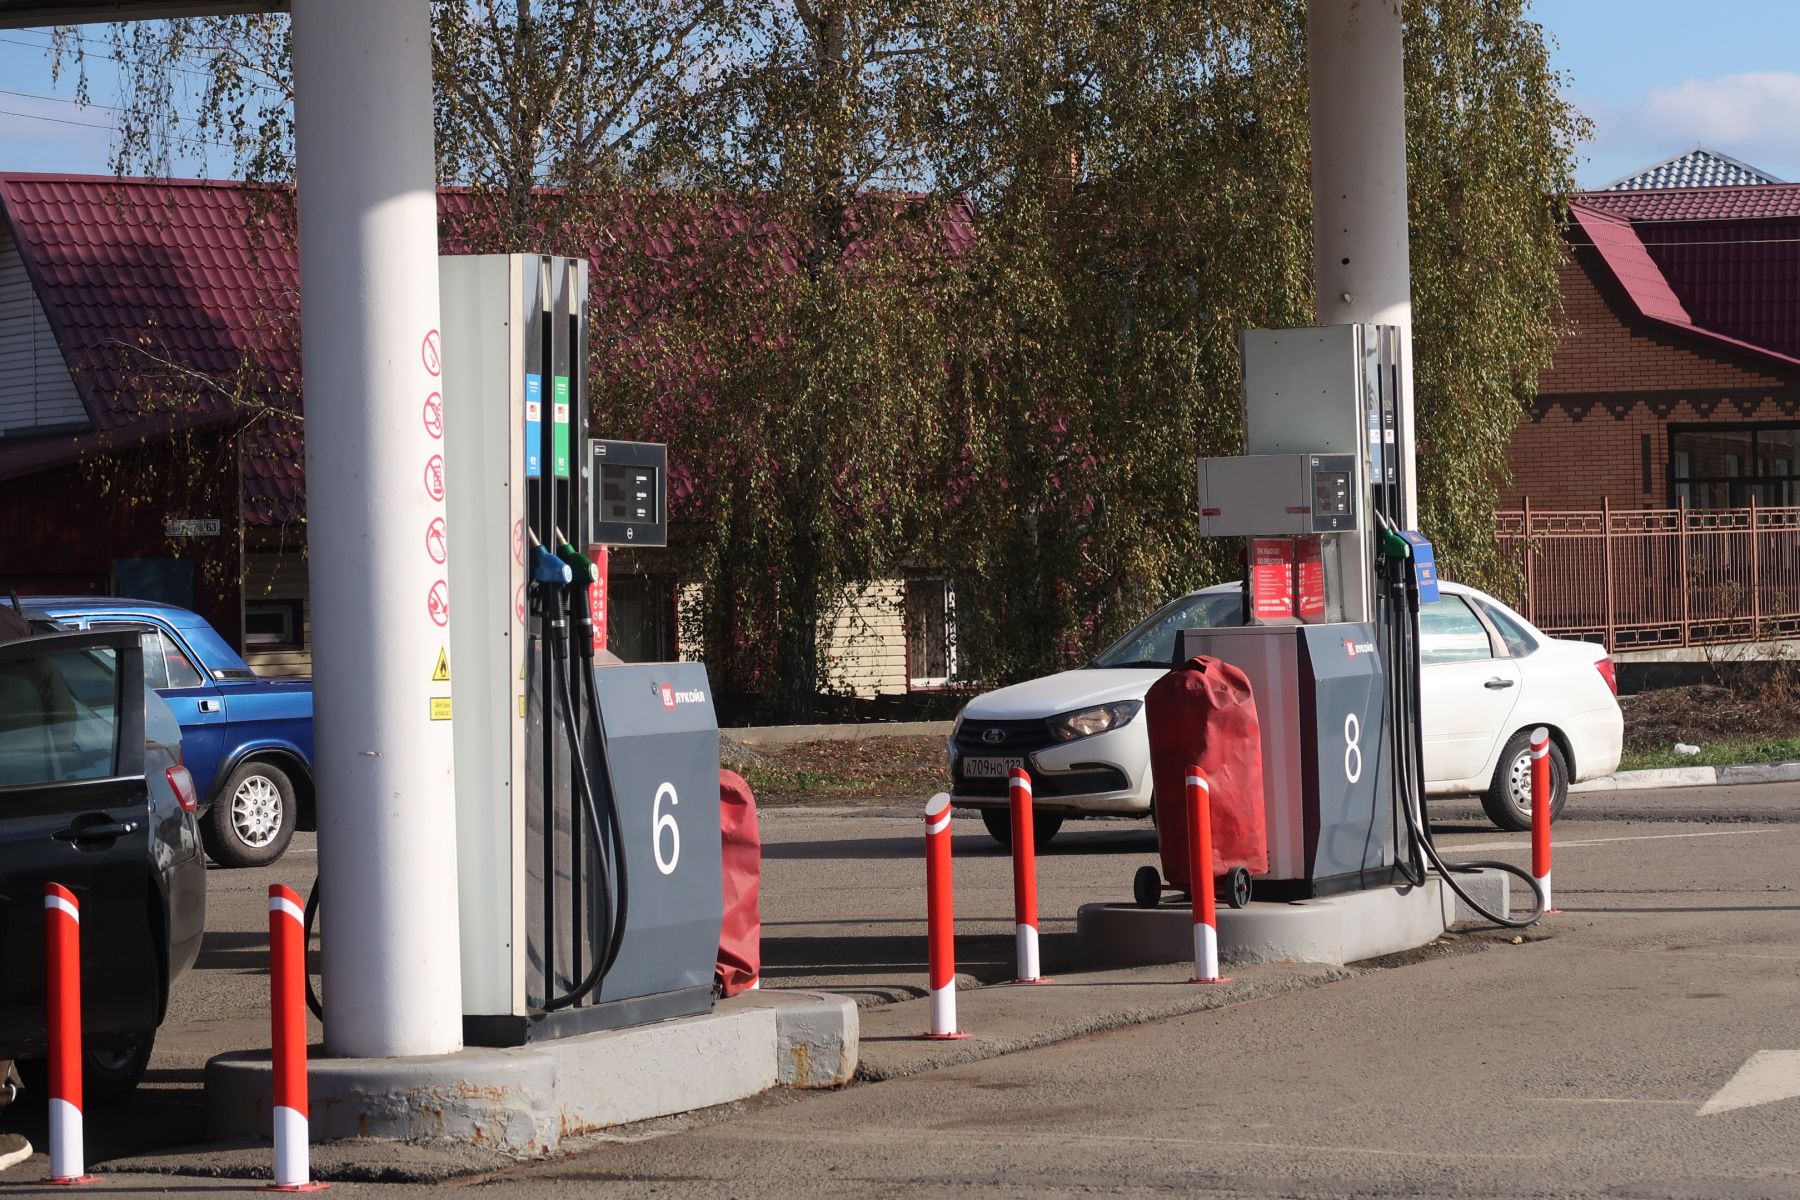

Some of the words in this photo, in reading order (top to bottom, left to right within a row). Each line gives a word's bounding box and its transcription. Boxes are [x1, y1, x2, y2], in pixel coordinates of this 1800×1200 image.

[206, 522, 217, 533] 63
[674, 687, 706, 704] ЛУКОЙЛ
[1344, 712, 1362, 784] 8
[652, 781, 681, 876] 6
